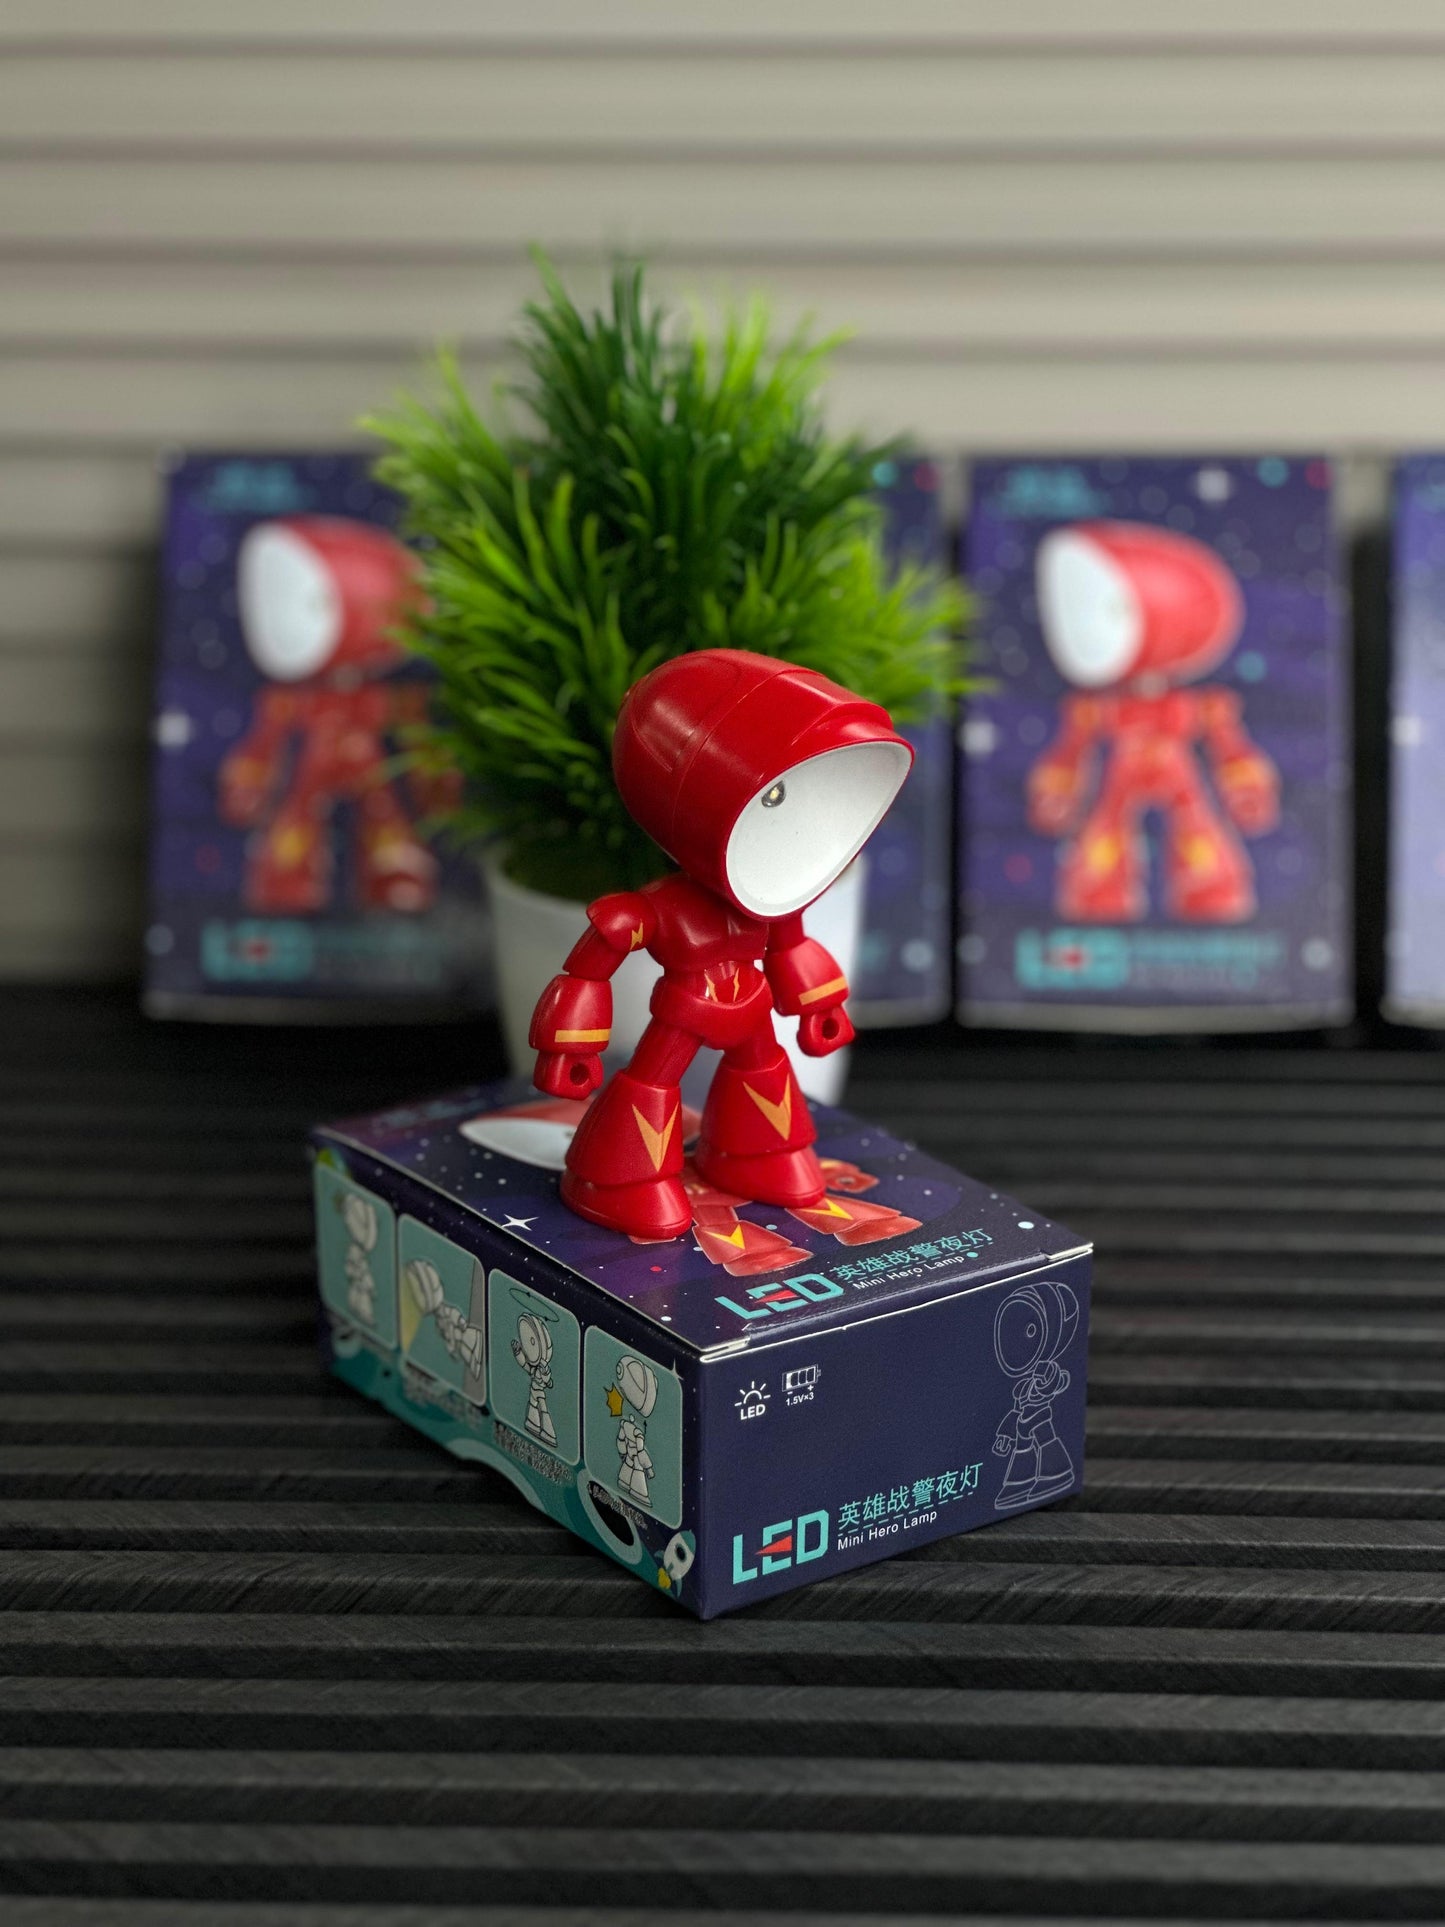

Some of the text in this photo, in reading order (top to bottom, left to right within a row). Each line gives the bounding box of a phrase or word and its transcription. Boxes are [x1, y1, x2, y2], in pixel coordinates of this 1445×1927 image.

[833, 1228, 993, 1281] 英雄战警夜灯
[853, 1255, 965, 1291] Mini Hero Lamp
[714, 1273, 844, 1320] LED
[740, 1404, 766, 1420] LED
[838, 1462, 983, 1530] 英雄战警夜灯
[733, 1509, 829, 1585] LED
[837, 1510, 937, 1551] Mini Hero Lamp
